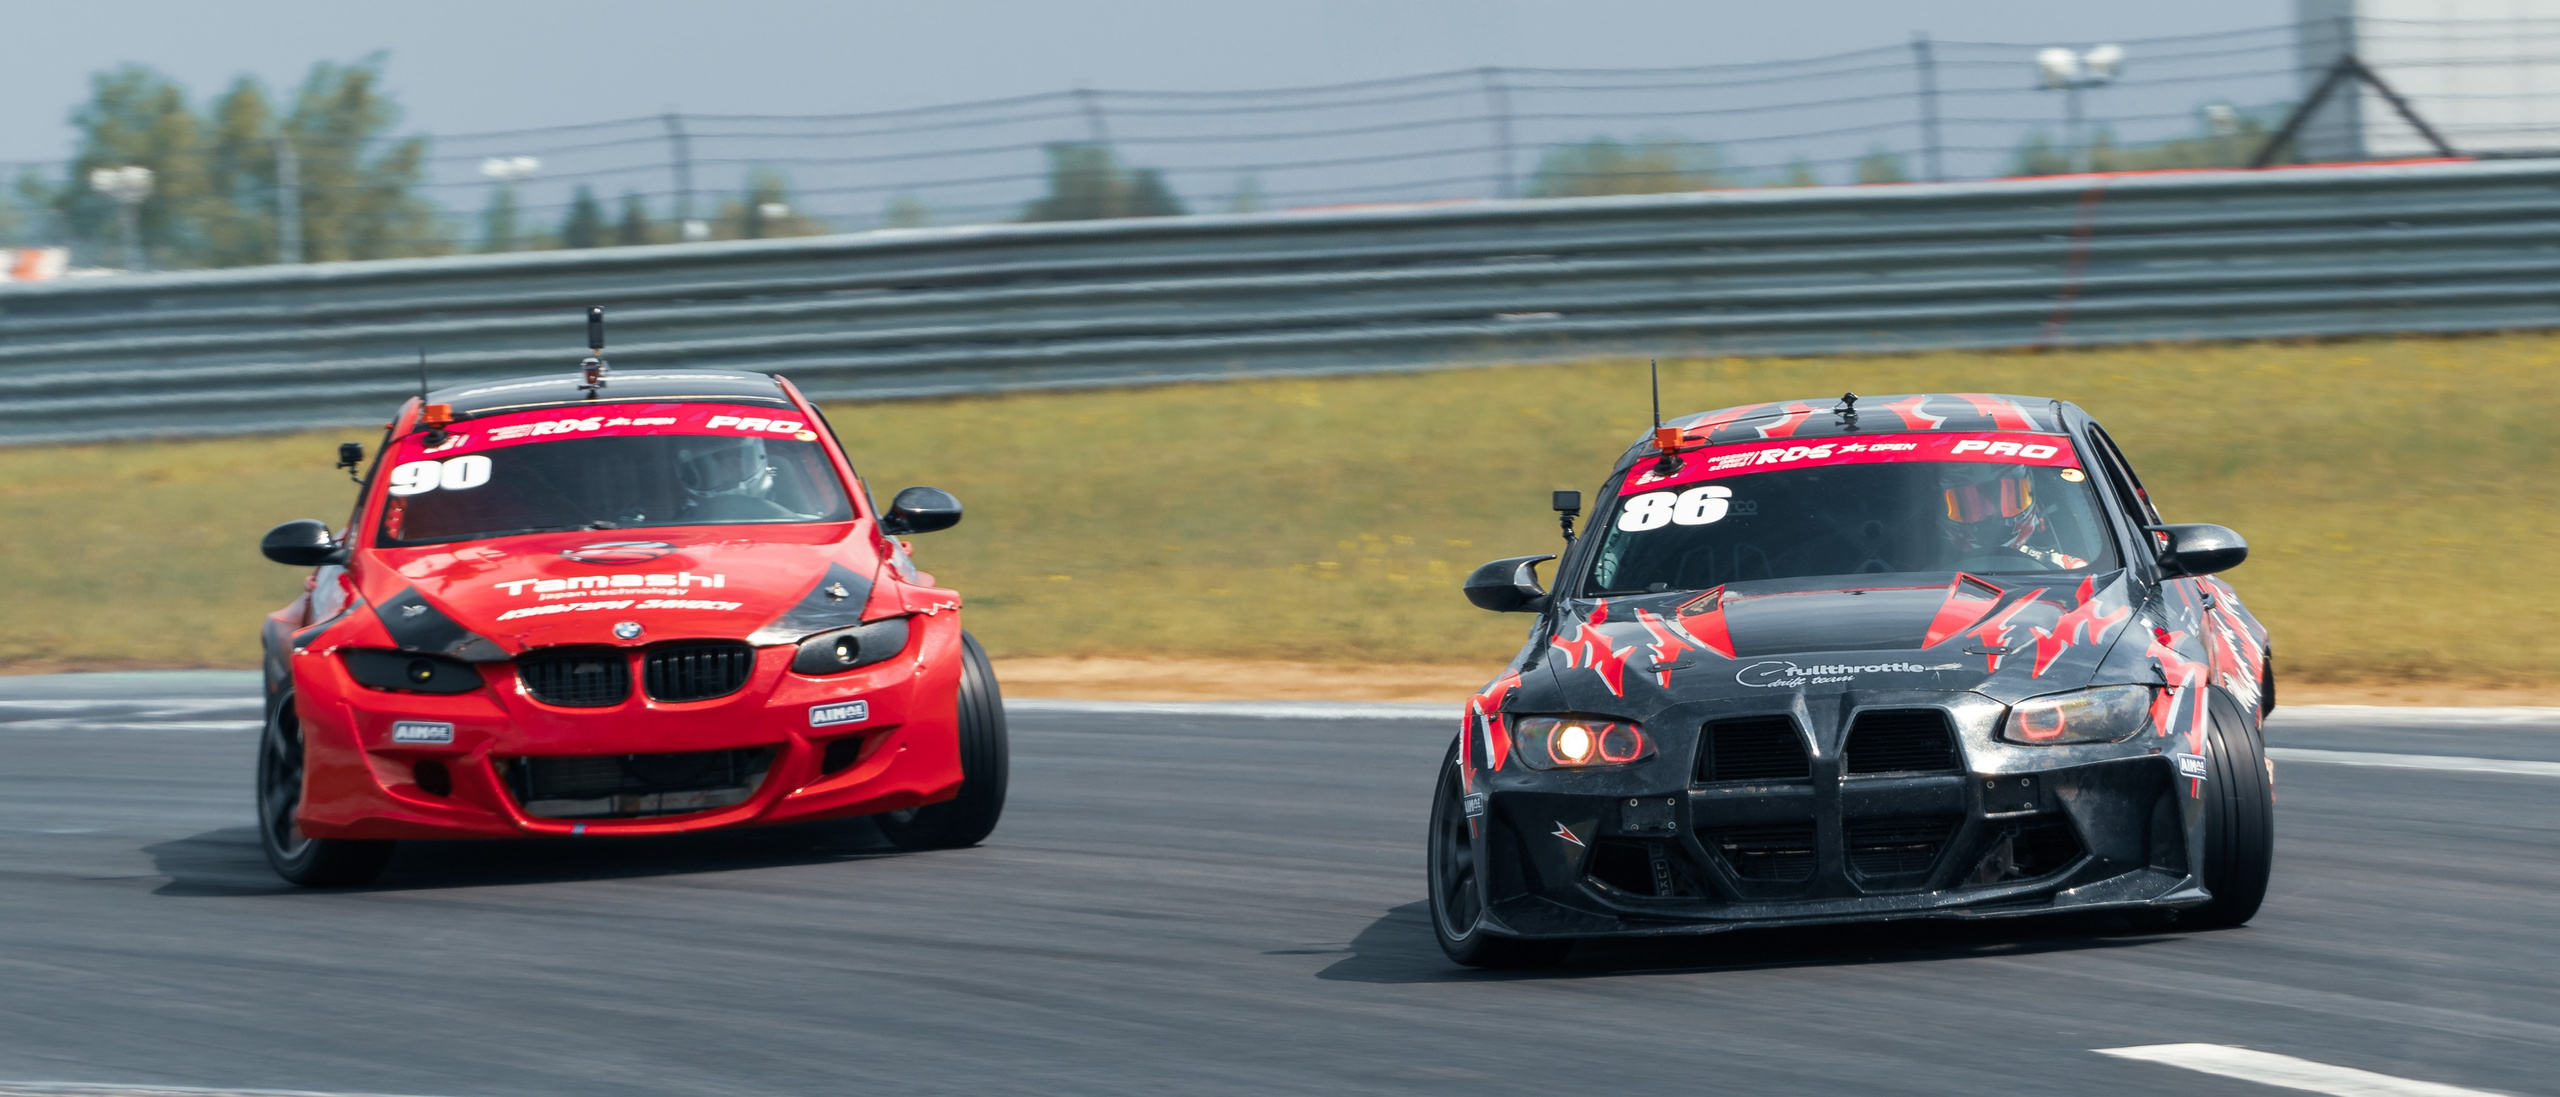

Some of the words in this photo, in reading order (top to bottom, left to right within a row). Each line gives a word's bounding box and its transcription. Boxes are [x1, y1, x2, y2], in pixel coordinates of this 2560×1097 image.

[705, 415, 803, 434] PRO
[1755, 443, 1838, 465] RDS
[1868, 443, 1918, 452] OPEN
[1951, 439, 2058, 459] PRO
[389, 455, 492, 496] 90
[1618, 485, 1733, 532] 86
[493, 571, 725, 596] Tamashi
[590, 587, 689, 596] technology
[1784, 662, 1925, 677] fullthrottle
[1767, 676, 1807, 688] drift
[1811, 675, 1856, 684] team
